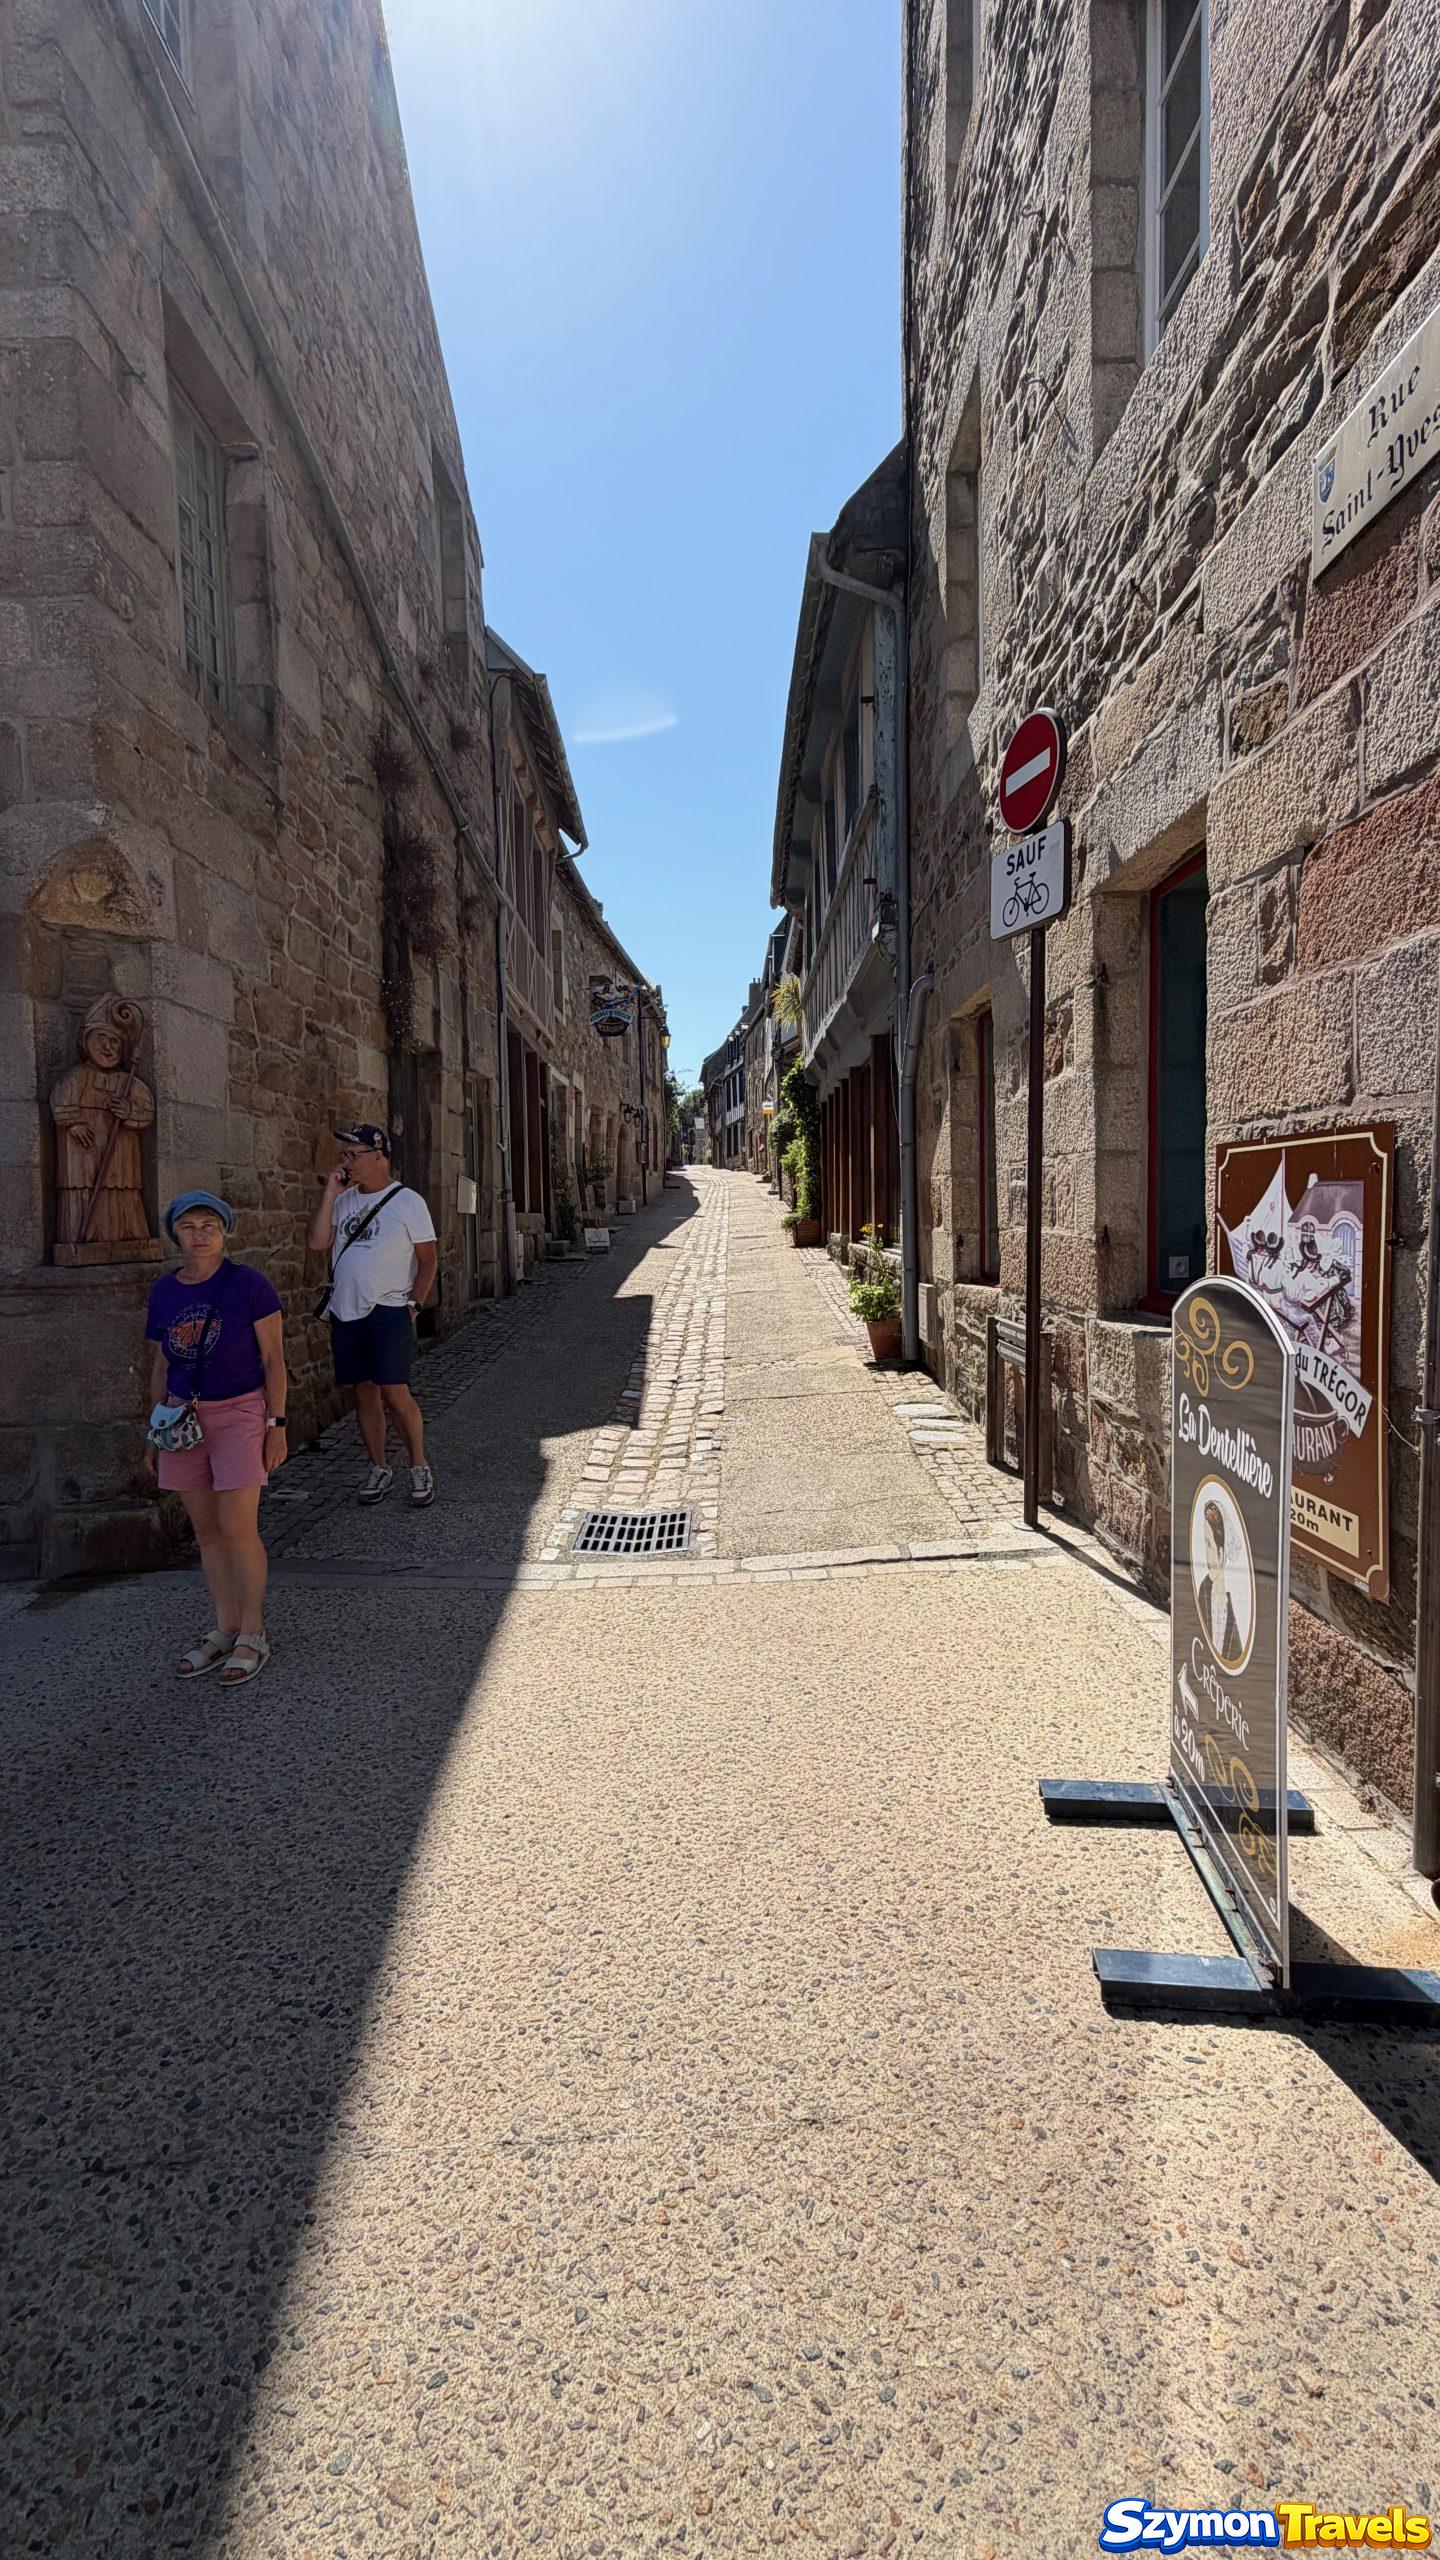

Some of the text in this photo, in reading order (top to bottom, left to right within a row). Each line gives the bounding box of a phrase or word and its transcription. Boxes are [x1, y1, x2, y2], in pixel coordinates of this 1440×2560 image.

[1367, 365, 1420, 448] Rue
[1006, 835, 1047, 876] SAUF
[1295, 1347, 1366, 1427] du TRÉGOR
[1178, 1392, 1274, 1499] La Dentellière
[1293, 1421, 1337, 1462] URANT
[1290, 1492, 1353, 1532] URANT
[1174, 1705, 1206, 1782] à 20m
